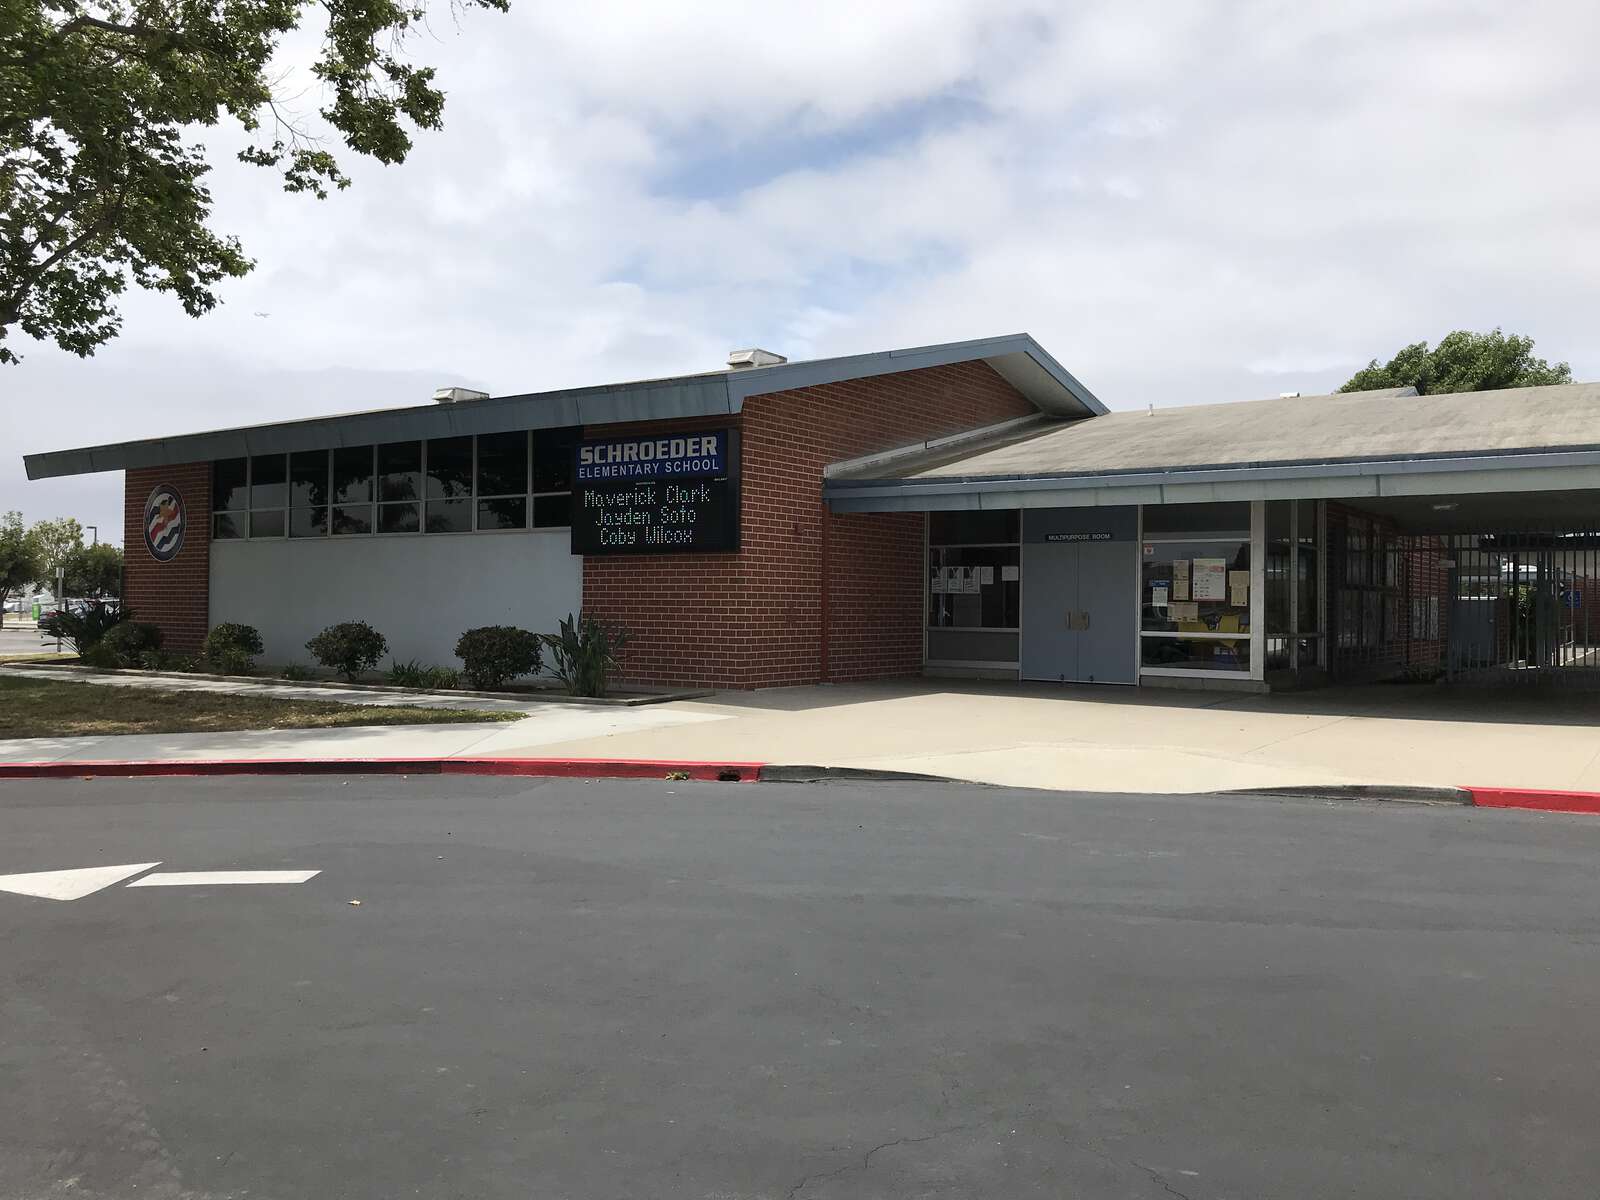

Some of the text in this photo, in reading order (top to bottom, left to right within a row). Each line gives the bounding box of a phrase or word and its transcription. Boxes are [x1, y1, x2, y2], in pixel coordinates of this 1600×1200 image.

[580, 436, 717, 465] SCHROEDER
[579, 458, 719, 478] ELEMENTARY SCHOOL
[584, 484, 710, 508] Maverick Clark
[595, 505, 696, 526] Jayden Soto
[600, 525, 693, 545] Coby Wilcox
